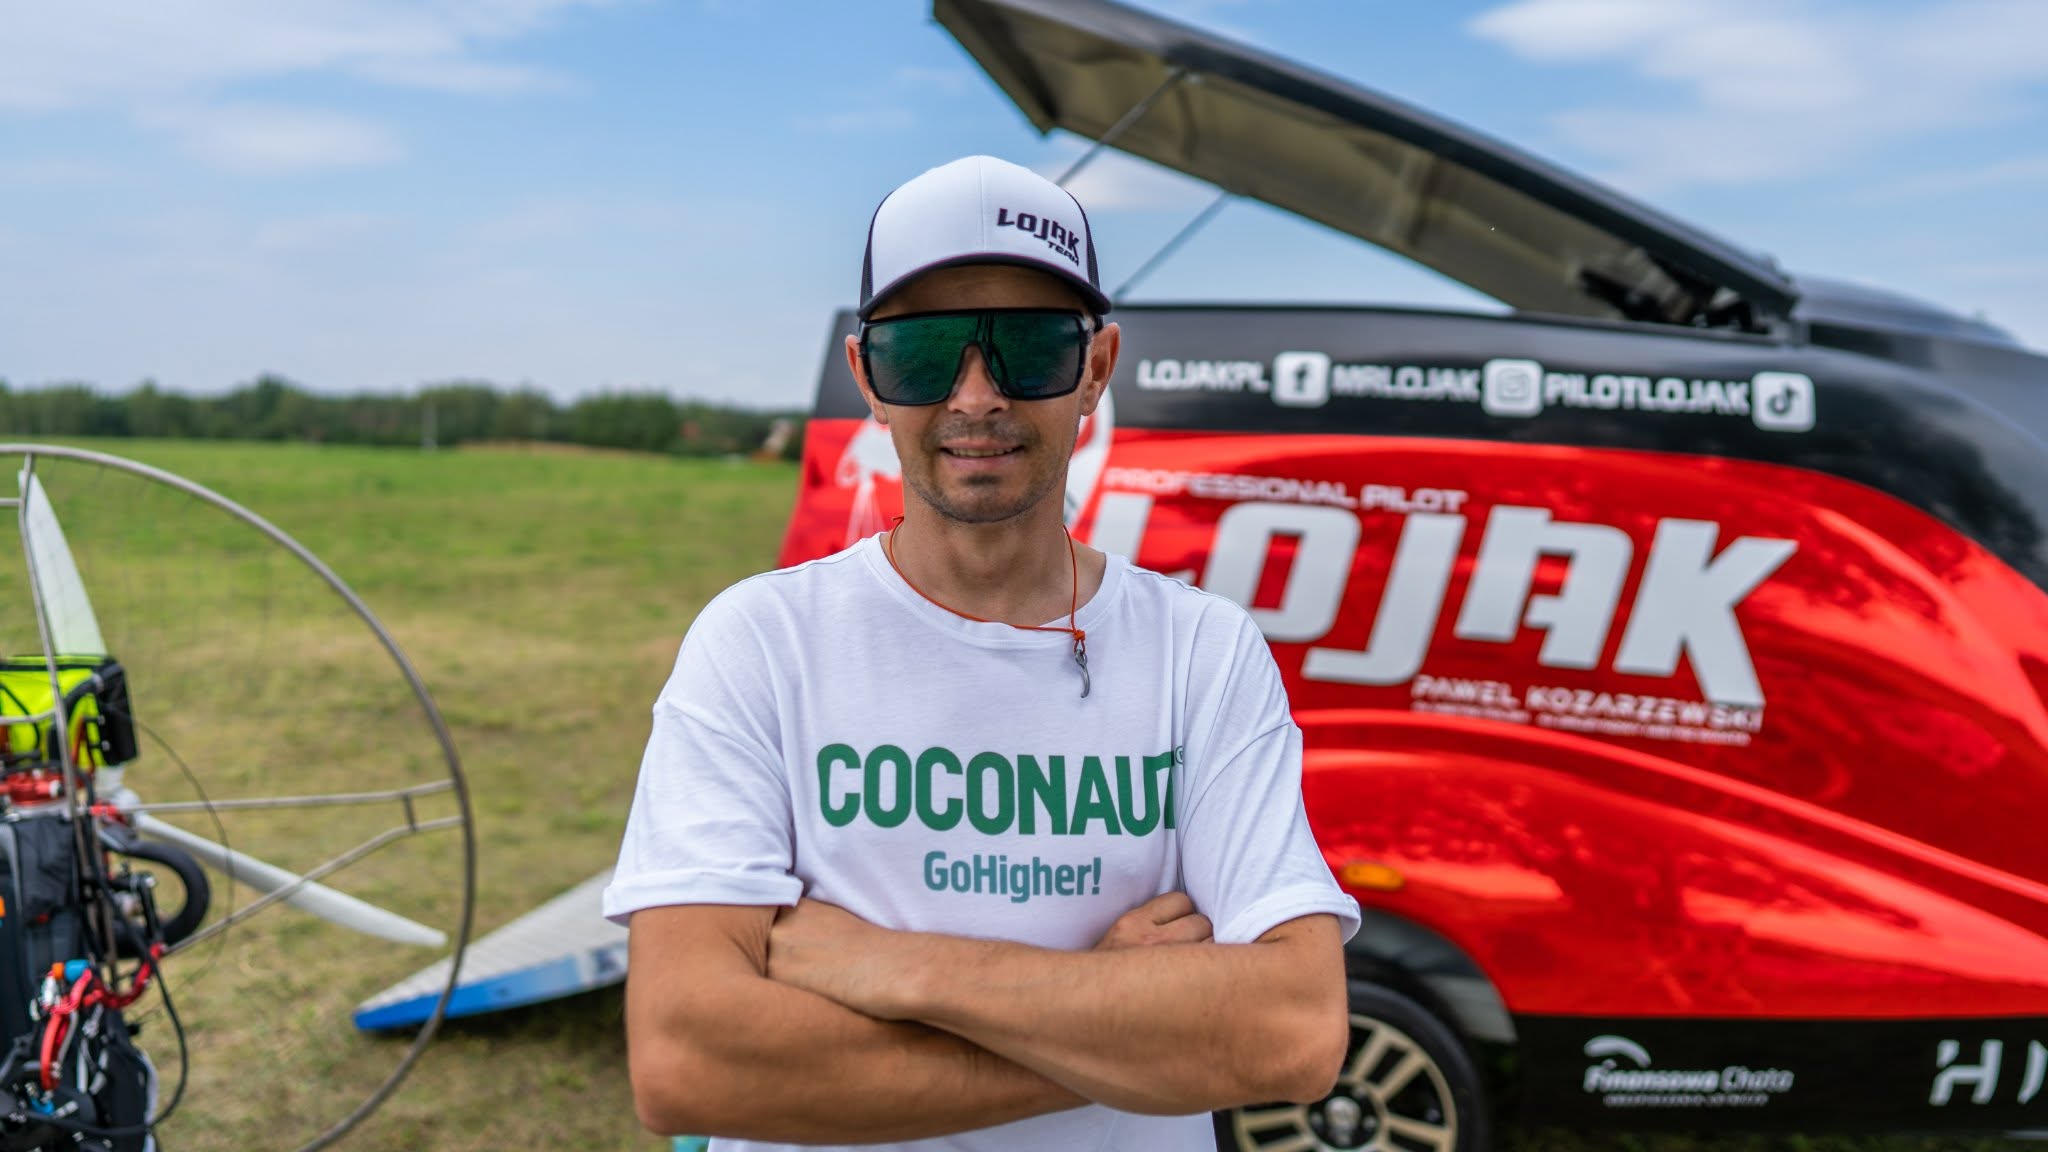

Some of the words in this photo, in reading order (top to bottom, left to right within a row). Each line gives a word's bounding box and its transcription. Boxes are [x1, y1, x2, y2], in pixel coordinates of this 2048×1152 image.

[997, 208, 1079, 262] LOJAK
[1048, 241, 1079, 267] TEAM
[1544, 372, 1751, 416] PILOTLOJAK
[1102, 468, 1358, 509] PROFESSIONAL
[1360, 484, 1468, 513] PILOT
[1525, 685, 1764, 733] KOZARZEWSKI
[923, 850, 1102, 904] GoHigher!
[1583, 1058, 1720, 1093] Finansowa
[1720, 1065, 1795, 1093] Chata
